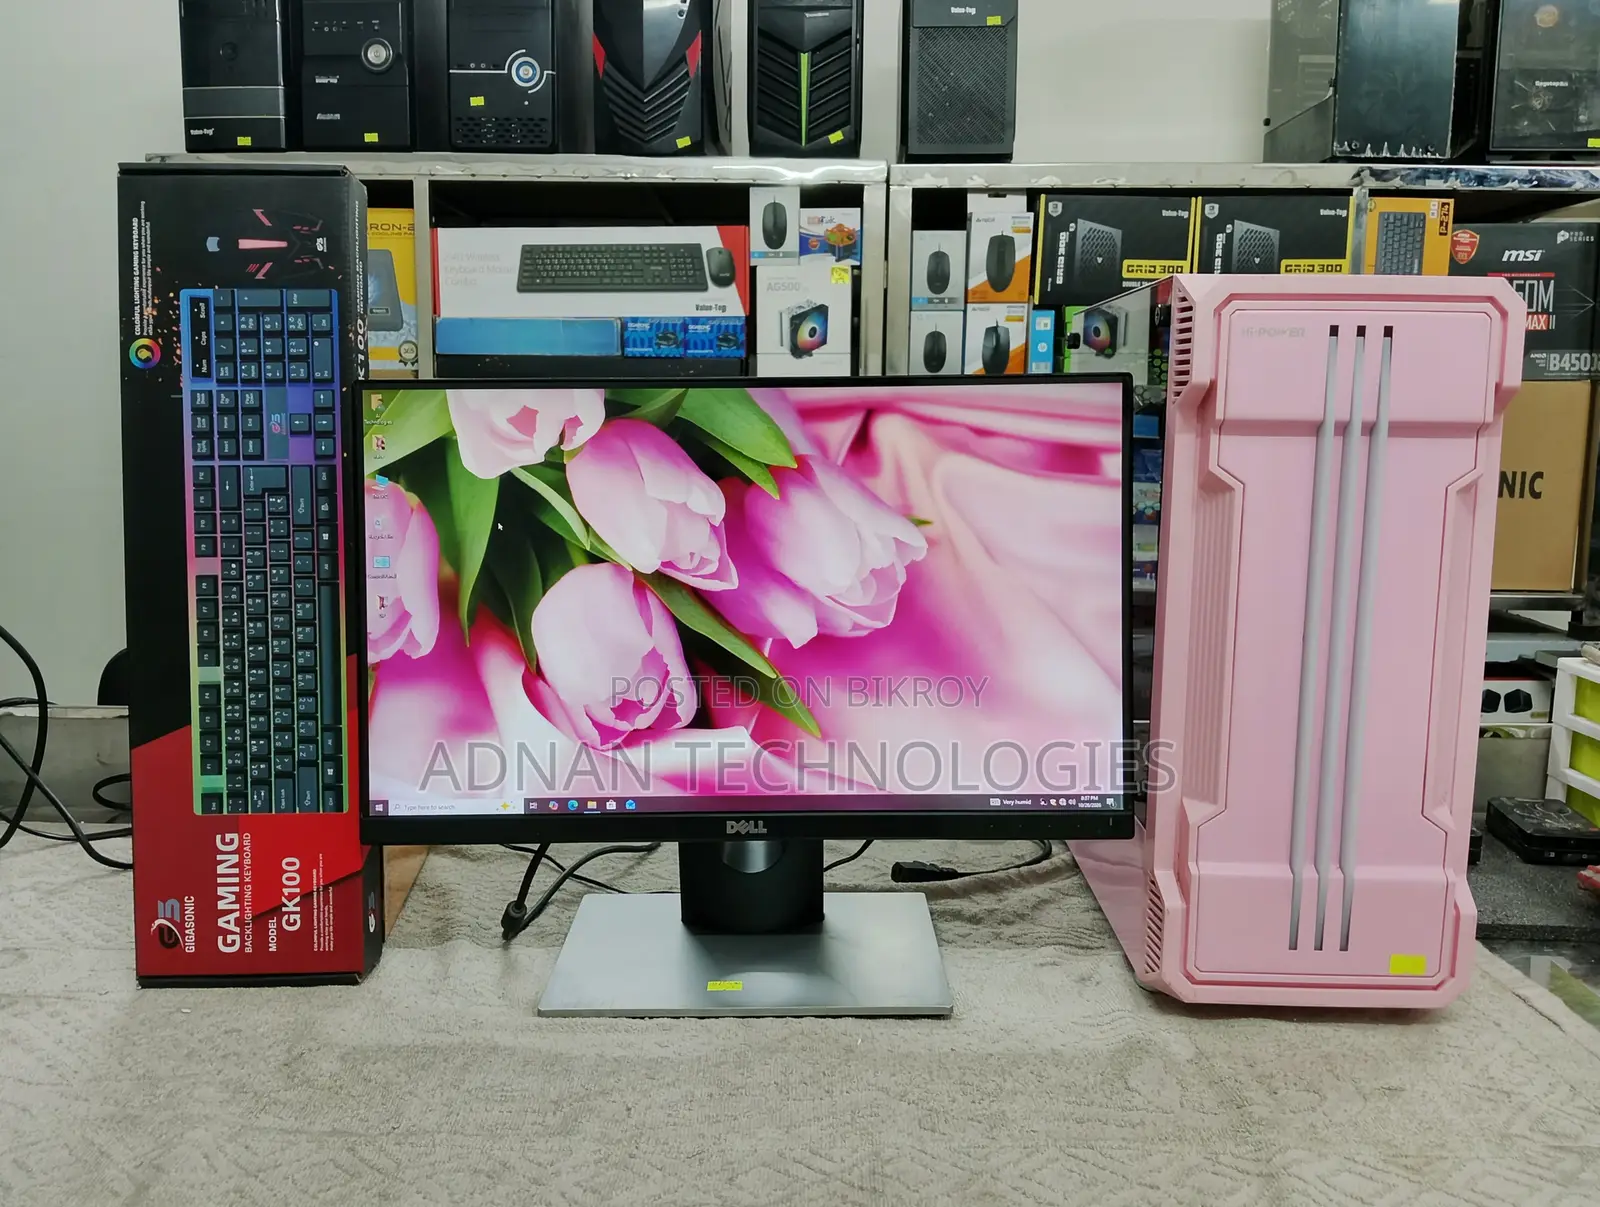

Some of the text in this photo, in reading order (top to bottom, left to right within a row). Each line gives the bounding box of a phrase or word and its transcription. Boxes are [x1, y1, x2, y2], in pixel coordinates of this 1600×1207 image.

[1284, 264, 1342, 273] GRID 300
[1502, 249, 1542, 262] msi
[1126, 264, 1184, 274] GRID 300
[1549, 353, 1591, 371] B450
[726, 820, 767, 834] DELL
[216, 833, 241, 953] GAMING
[243, 833, 252, 953] BACKLIGHTING KEYBOARD
[282, 857, 300, 931] GK100
[184, 896, 195, 952] GIGASONIC
[269, 917, 277, 952] MODEL
